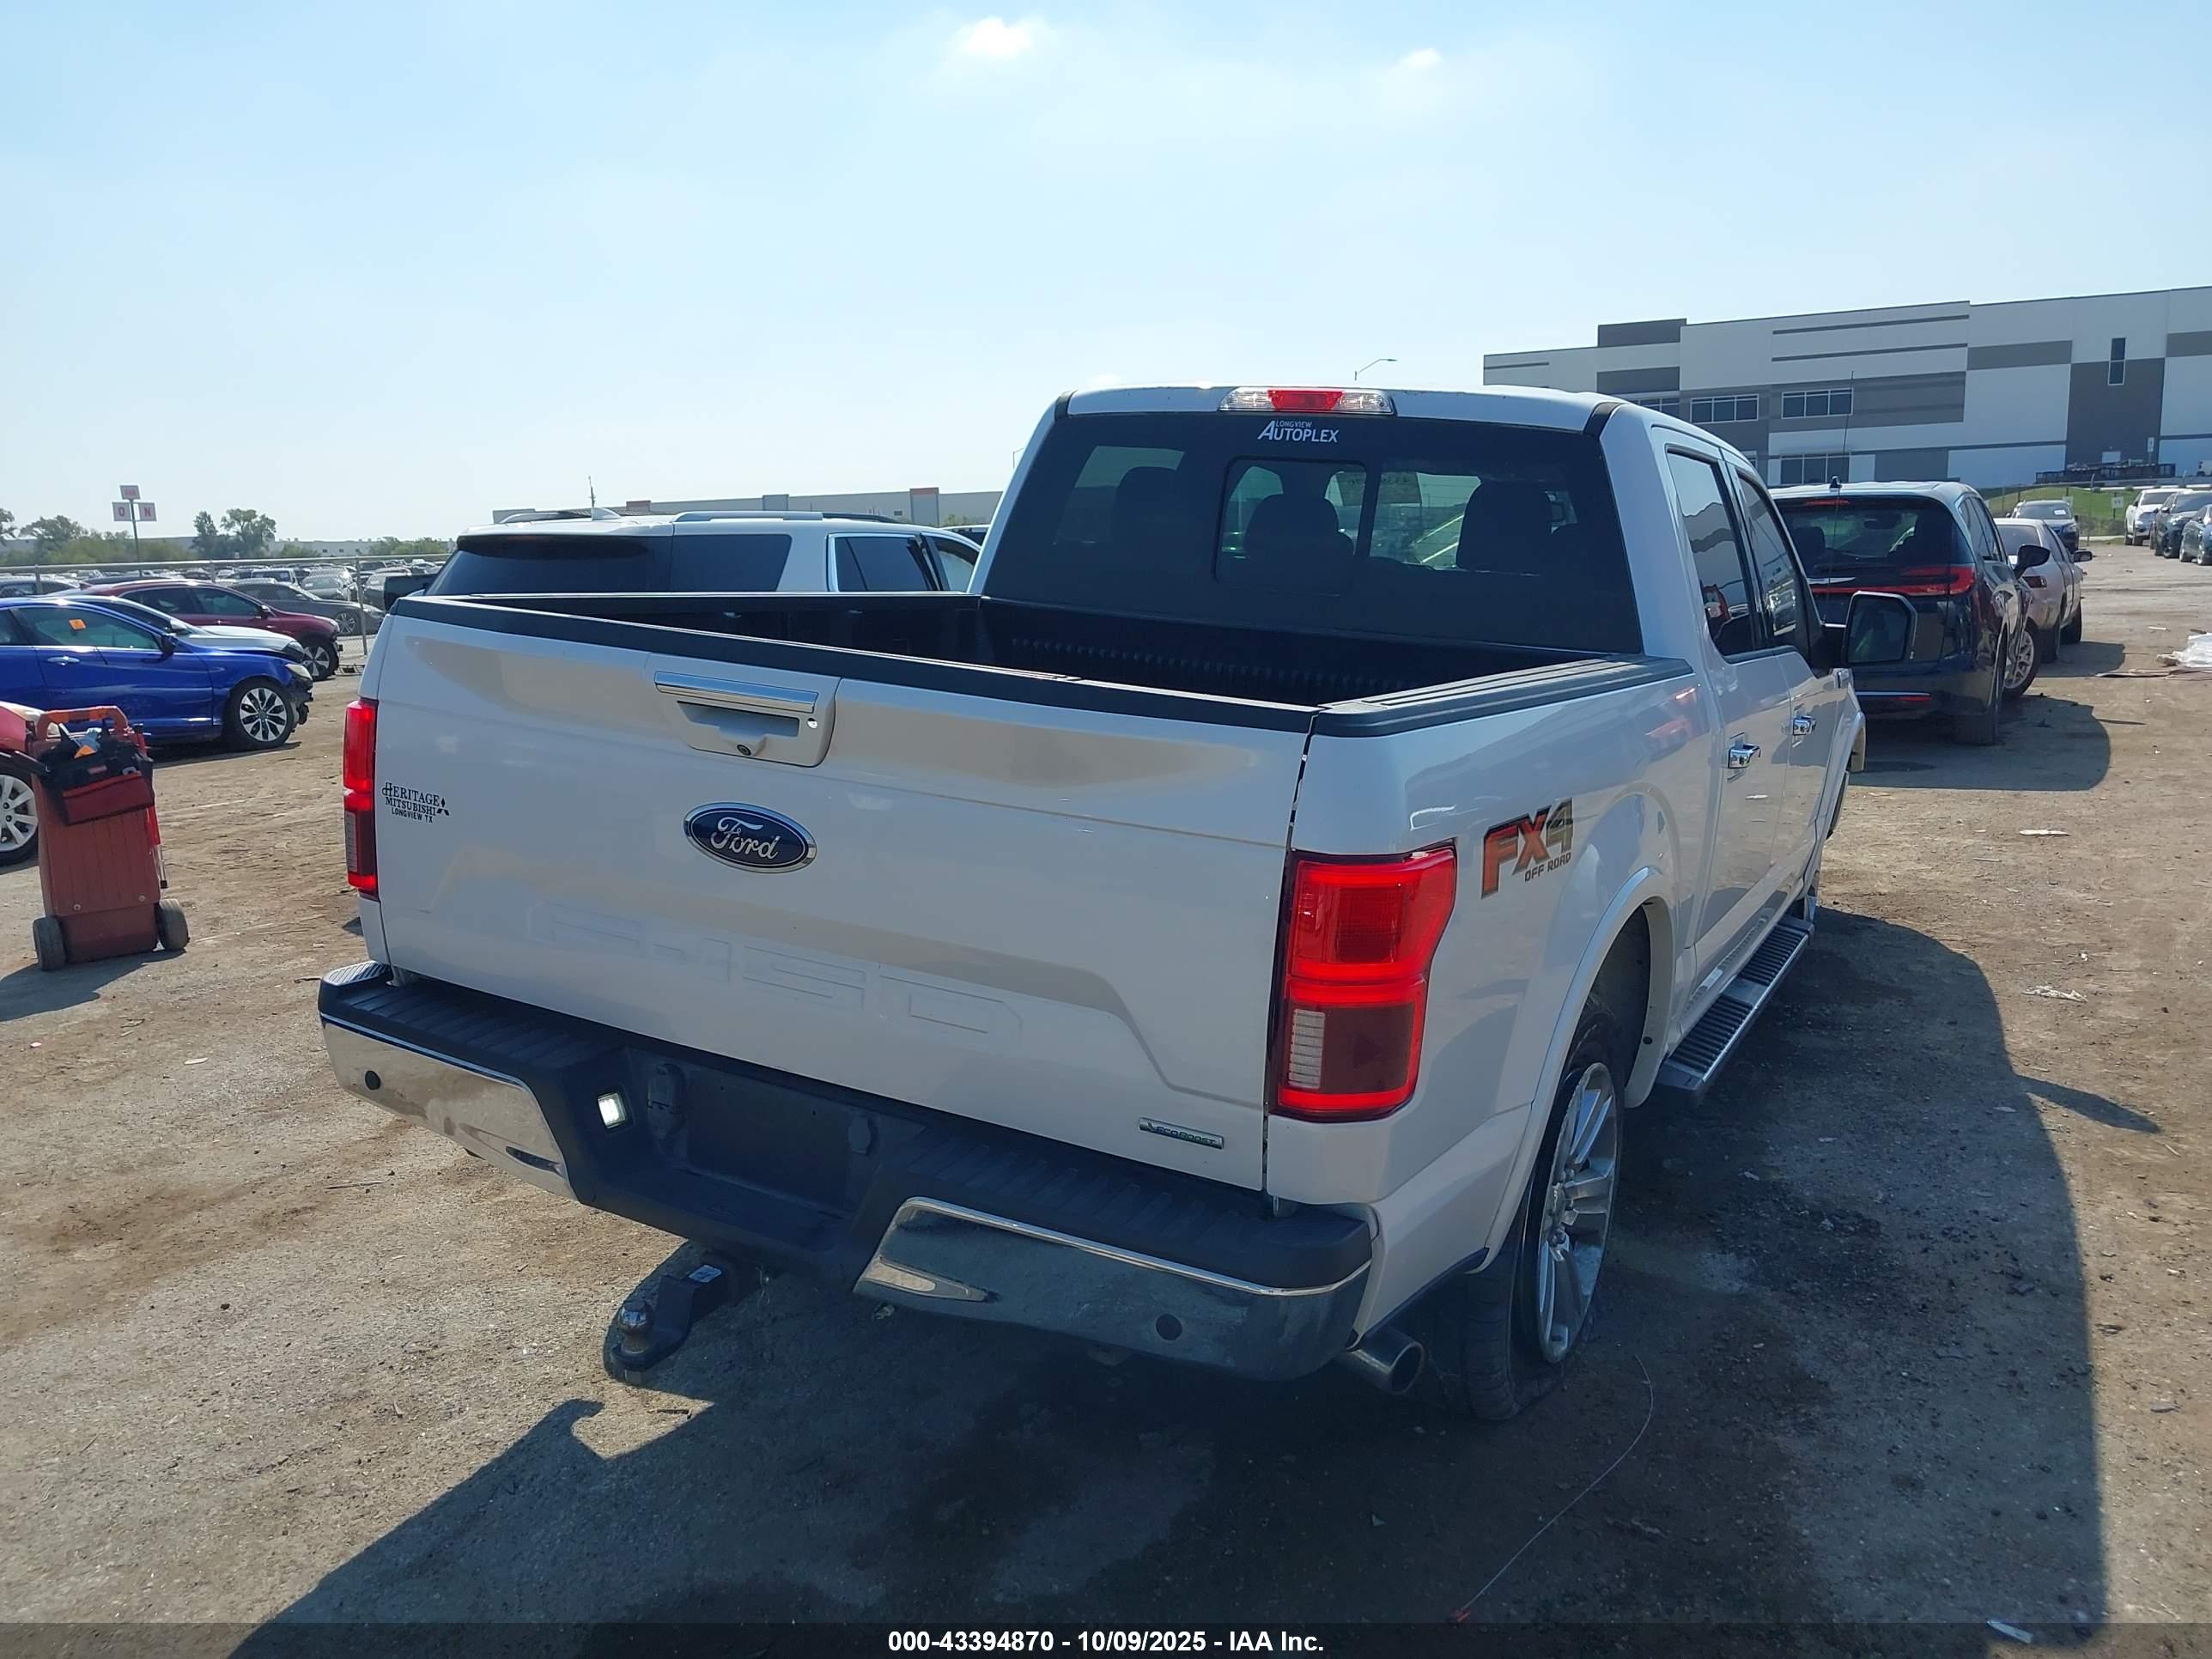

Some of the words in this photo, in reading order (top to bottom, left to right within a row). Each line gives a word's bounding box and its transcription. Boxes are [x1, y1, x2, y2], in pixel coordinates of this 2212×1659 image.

[1257, 420, 1340, 443] AUTOPLEX
[382, 782, 441, 807] HERITAGE
[385, 797, 436, 816] MITSUBISHI
[392, 807, 422, 821] LONGVIEW
[424, 814, 433, 823] TX
[710, 817, 780, 859] Ford
[1480, 797, 1573, 900] FX4
[1524, 865, 1545, 882] OFF
[1547, 852, 1571, 872] ROAD
